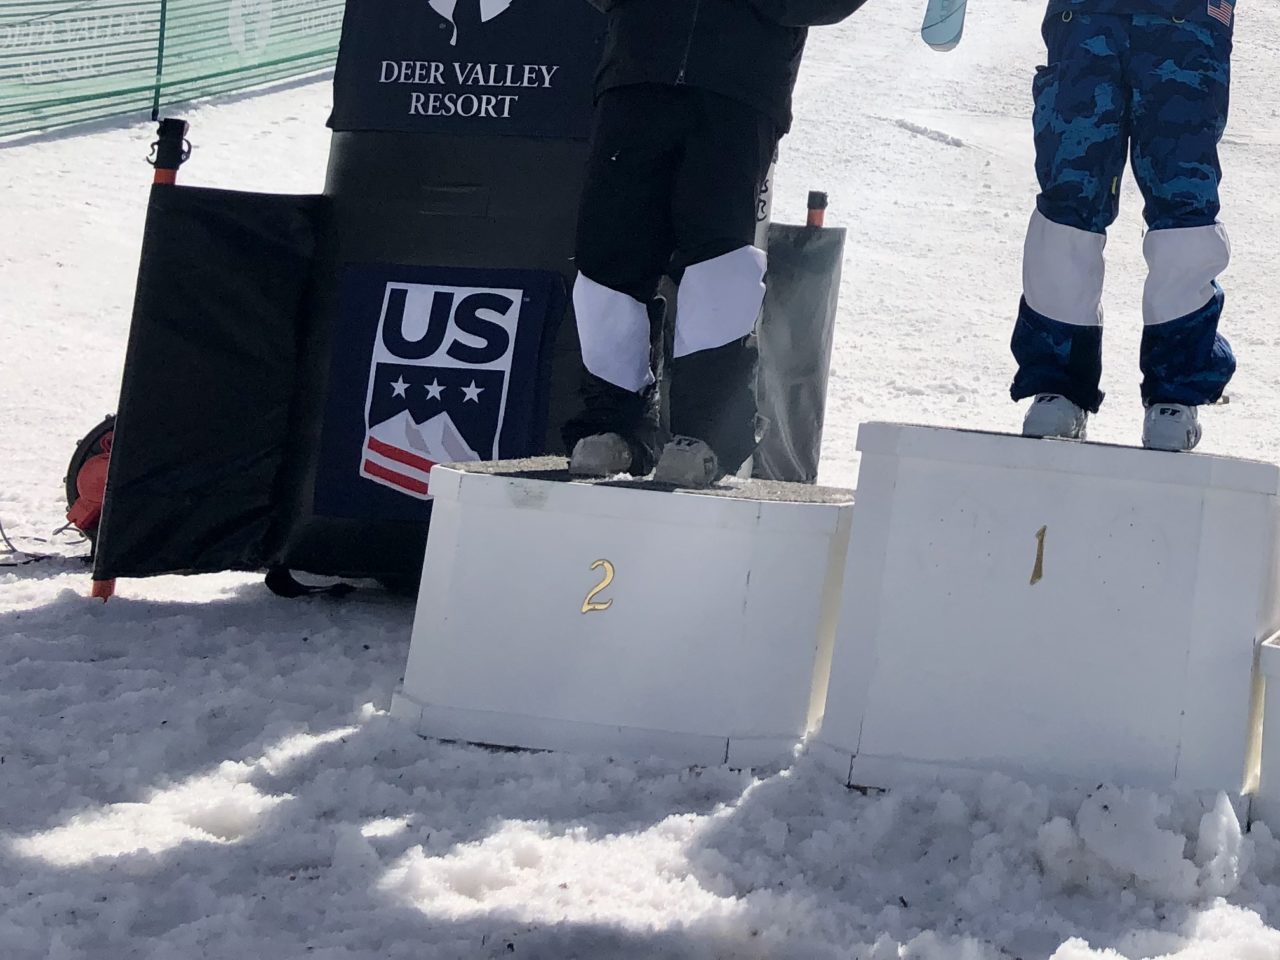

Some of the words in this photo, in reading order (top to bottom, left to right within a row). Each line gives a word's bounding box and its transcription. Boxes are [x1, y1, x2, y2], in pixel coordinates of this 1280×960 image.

[379, 60, 447, 87] DEER
[450, 62, 559, 89] VALLEY
[408, 91, 519, 118] RESORT
[381, 287, 514, 364] US
[1030, 524, 1048, 587] 1
[581, 558, 616, 615] 2
